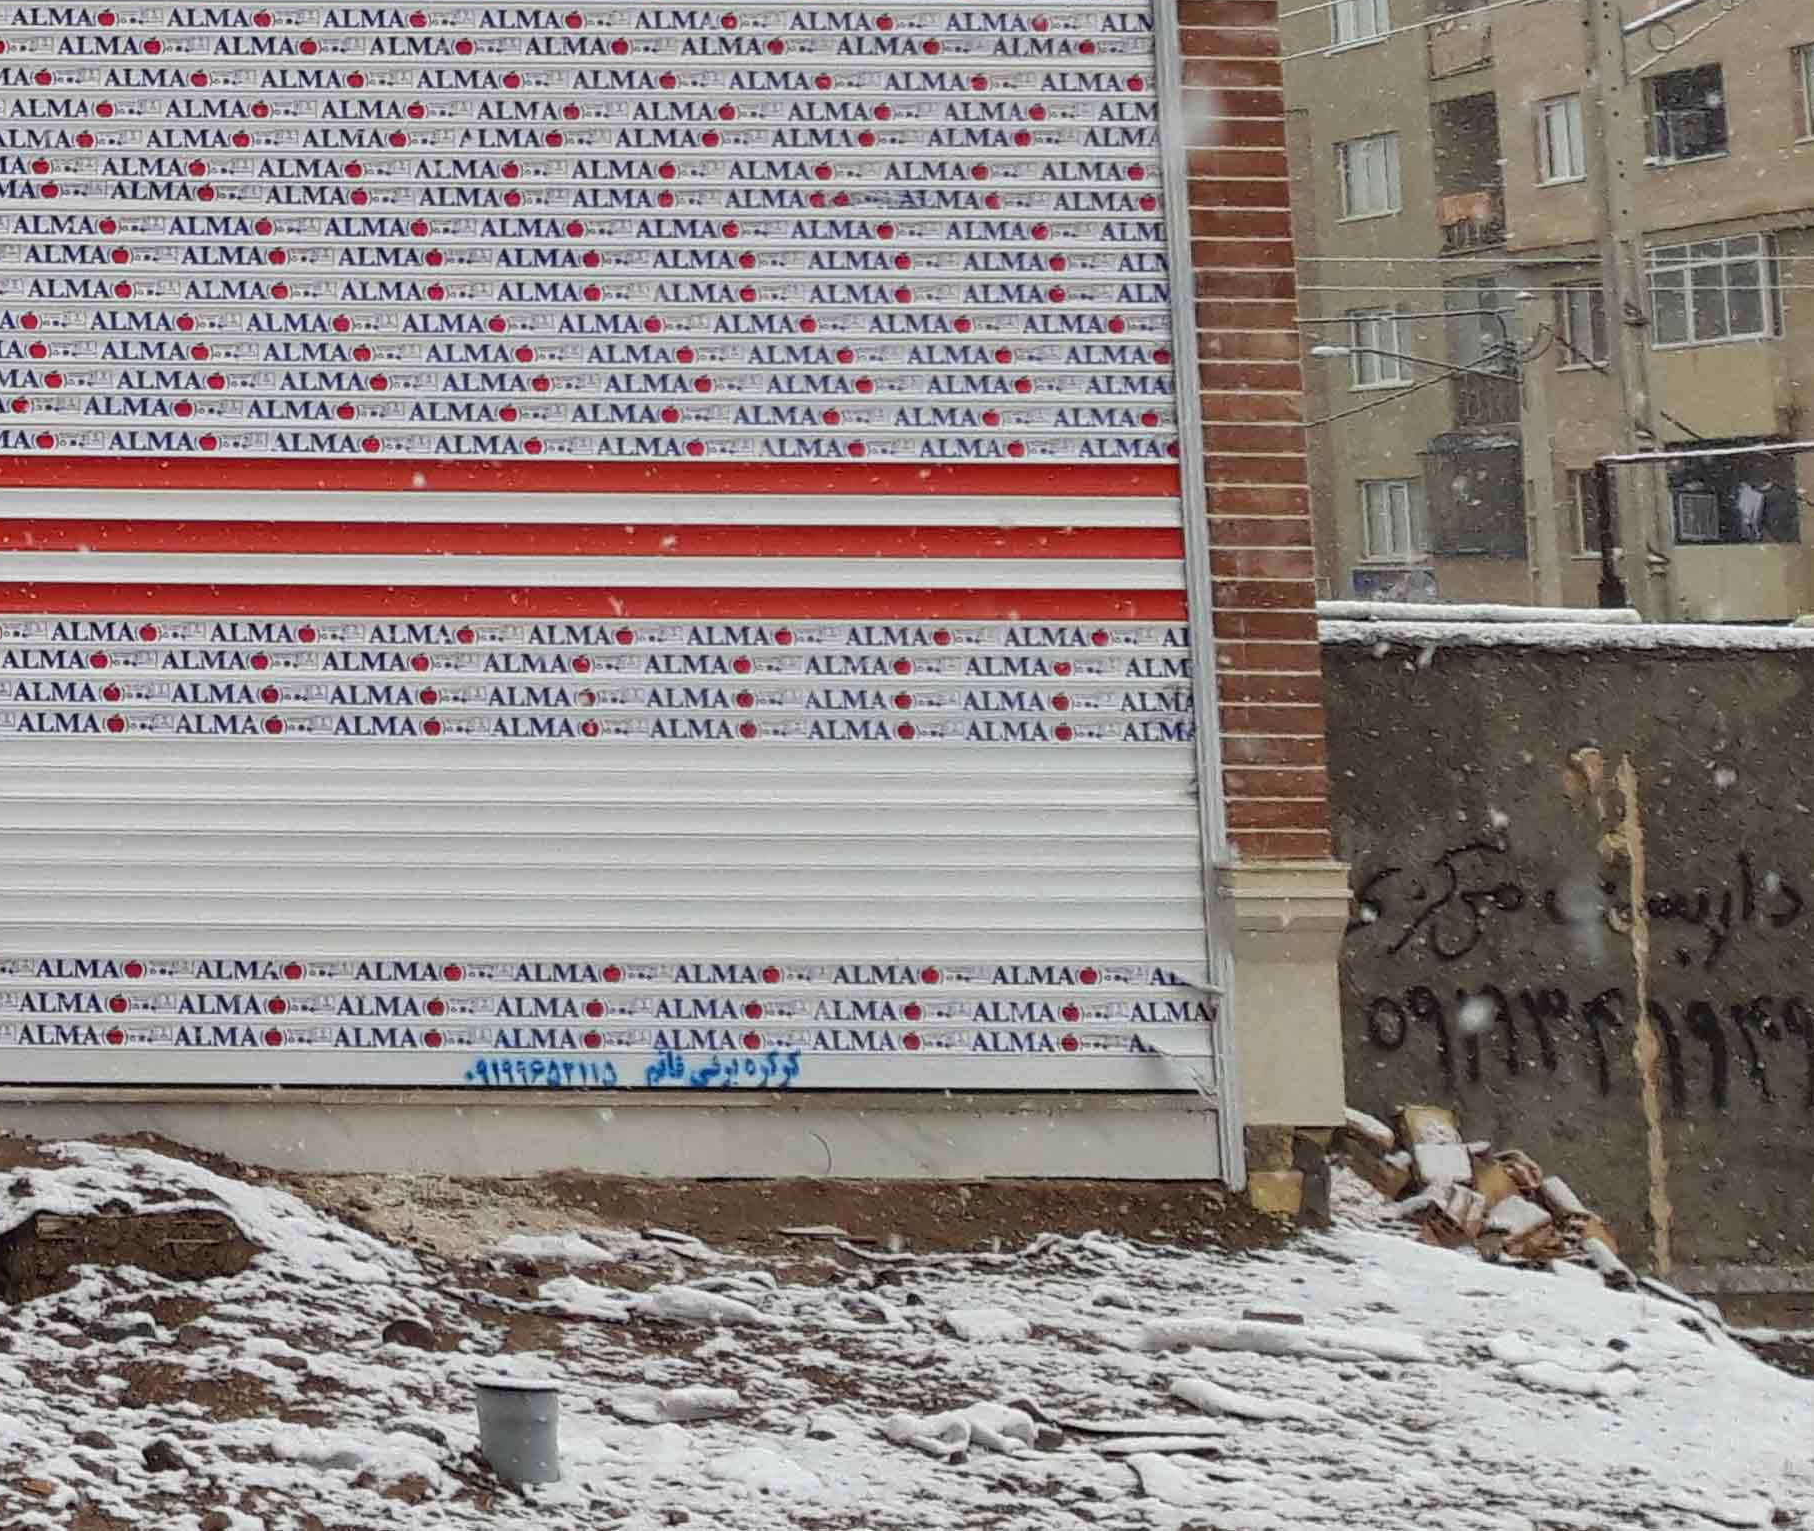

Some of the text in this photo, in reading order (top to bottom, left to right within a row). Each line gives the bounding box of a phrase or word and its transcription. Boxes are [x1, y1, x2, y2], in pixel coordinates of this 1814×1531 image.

[14, 214, 1028, 241] ALMA ALMA ALMA ALMA ALMA ALMA ALMA
[83, 396, 1137, 428] ALMA ALMA ALMA ALMA ALMA ALMA ALMA
[35, 958, 1075, 986] ALMA ALMA ALMA ALMA ALMA ALMA ALMA
